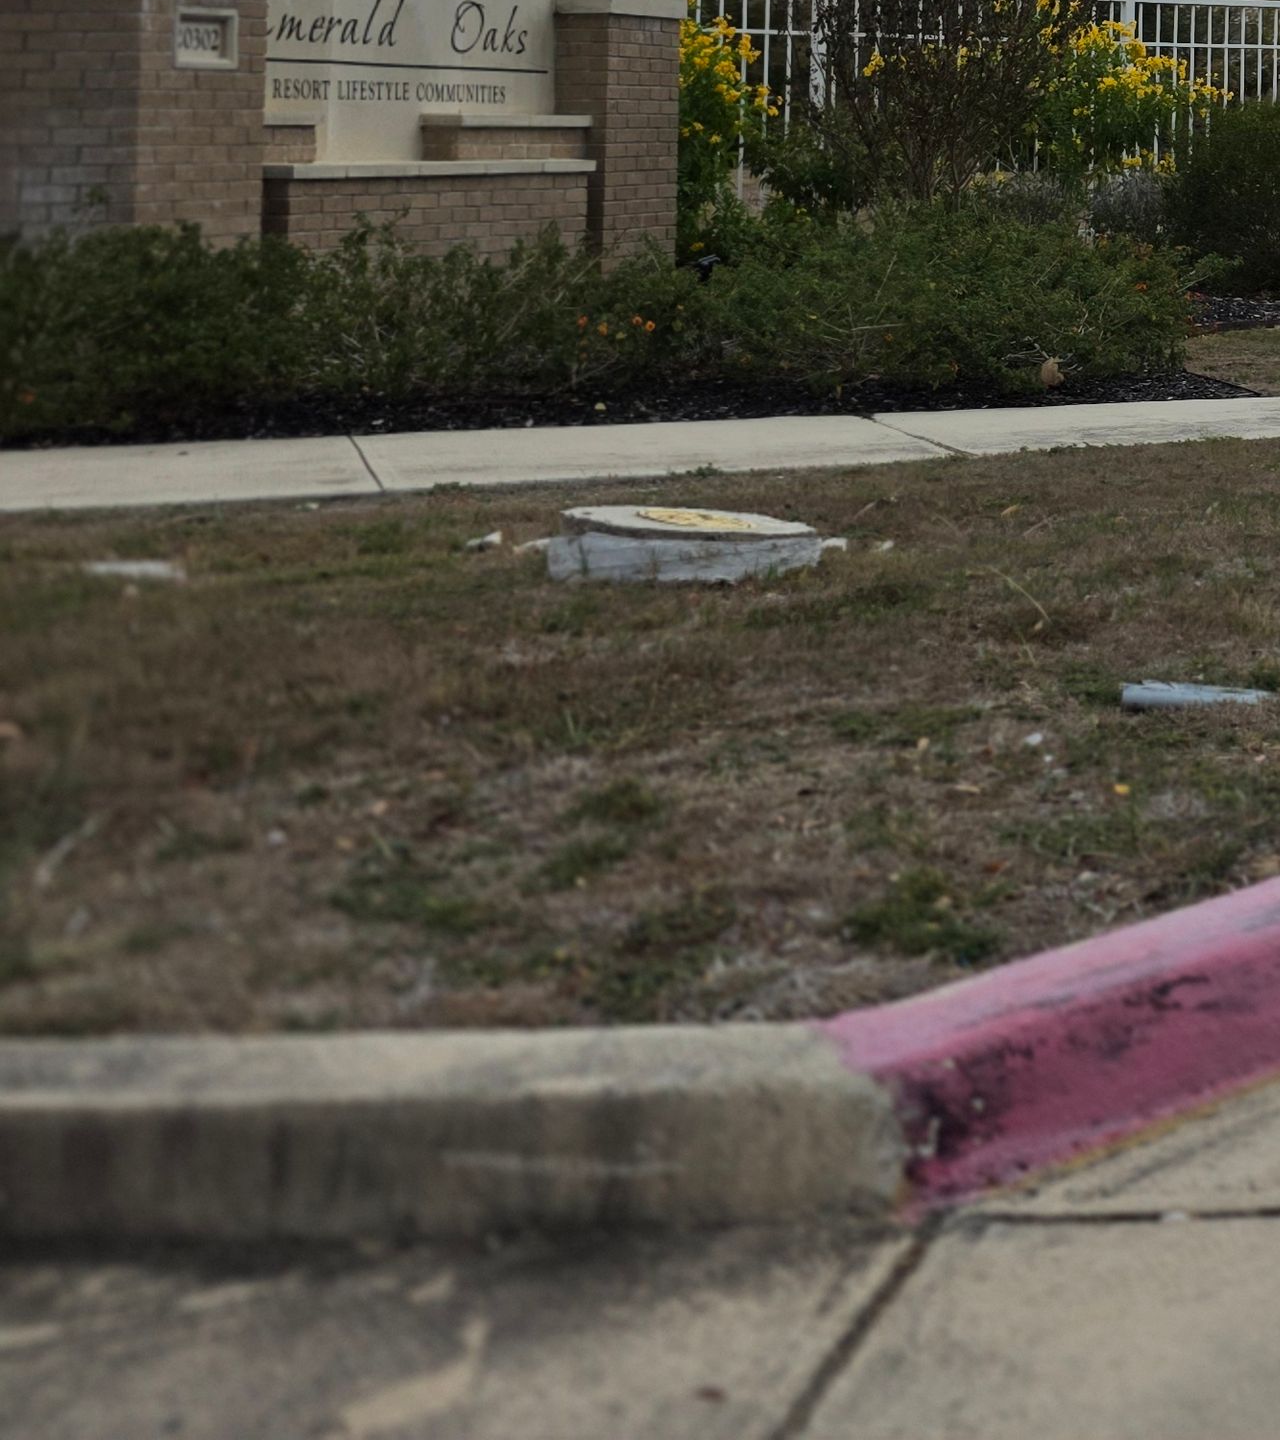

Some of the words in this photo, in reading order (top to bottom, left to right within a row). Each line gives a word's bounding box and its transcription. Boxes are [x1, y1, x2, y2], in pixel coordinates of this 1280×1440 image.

[450, 0, 529, 55] Oaks
[272, 77, 331, 101] RESORT
[337, 79, 410, 102] LIFESTYLE
[416, 81, 506, 105] COMMUNITIES
